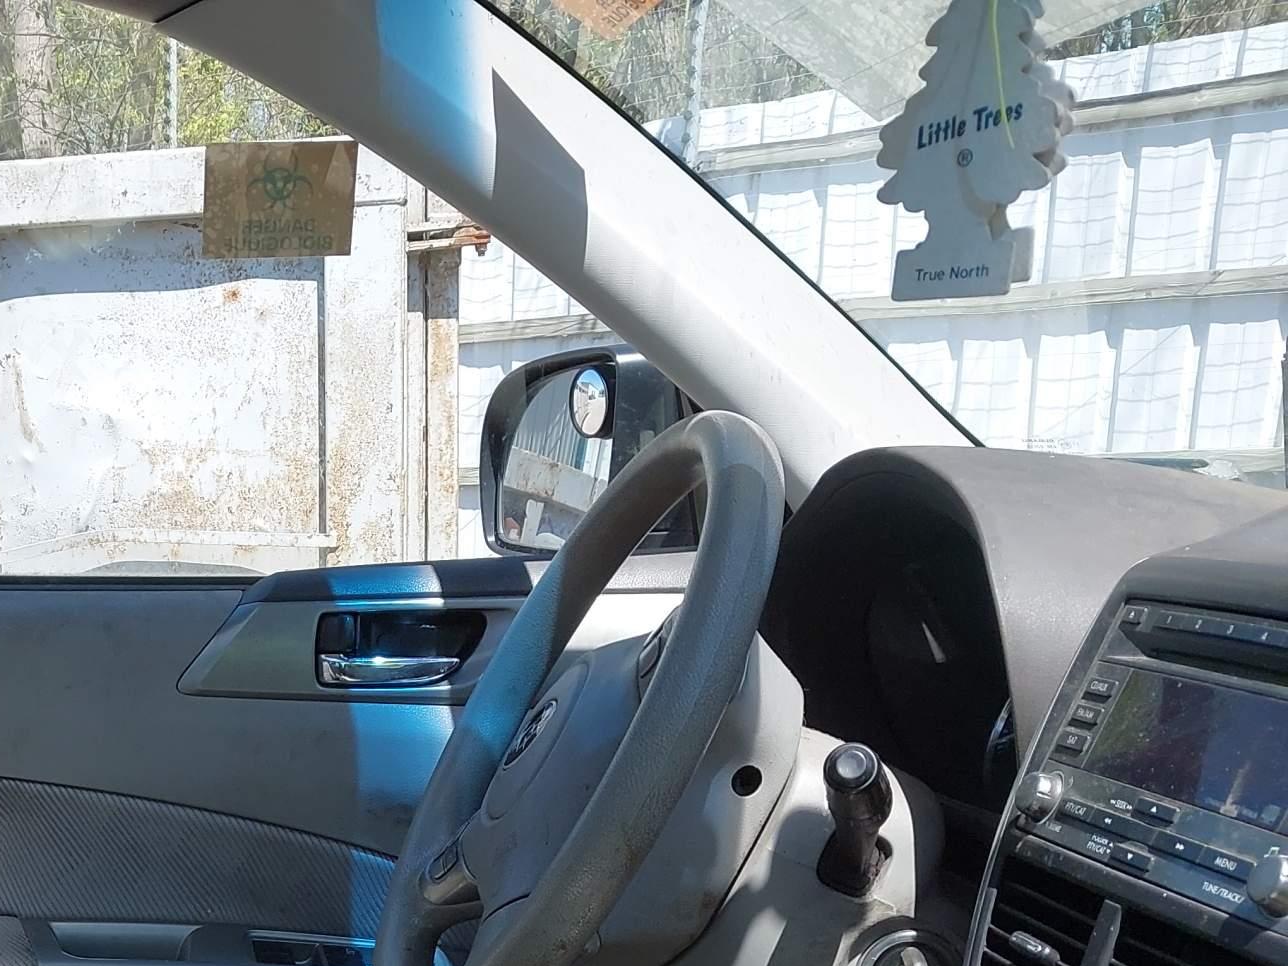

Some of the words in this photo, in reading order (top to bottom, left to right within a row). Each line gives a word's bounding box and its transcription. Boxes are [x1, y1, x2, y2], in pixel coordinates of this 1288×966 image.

[916, 115, 967, 150] Little
[973, 102, 1024, 132] Trees
[915, 268, 945, 281] True
[949, 264, 989, 279] North
[1214, 856, 1238, 871] MENU
